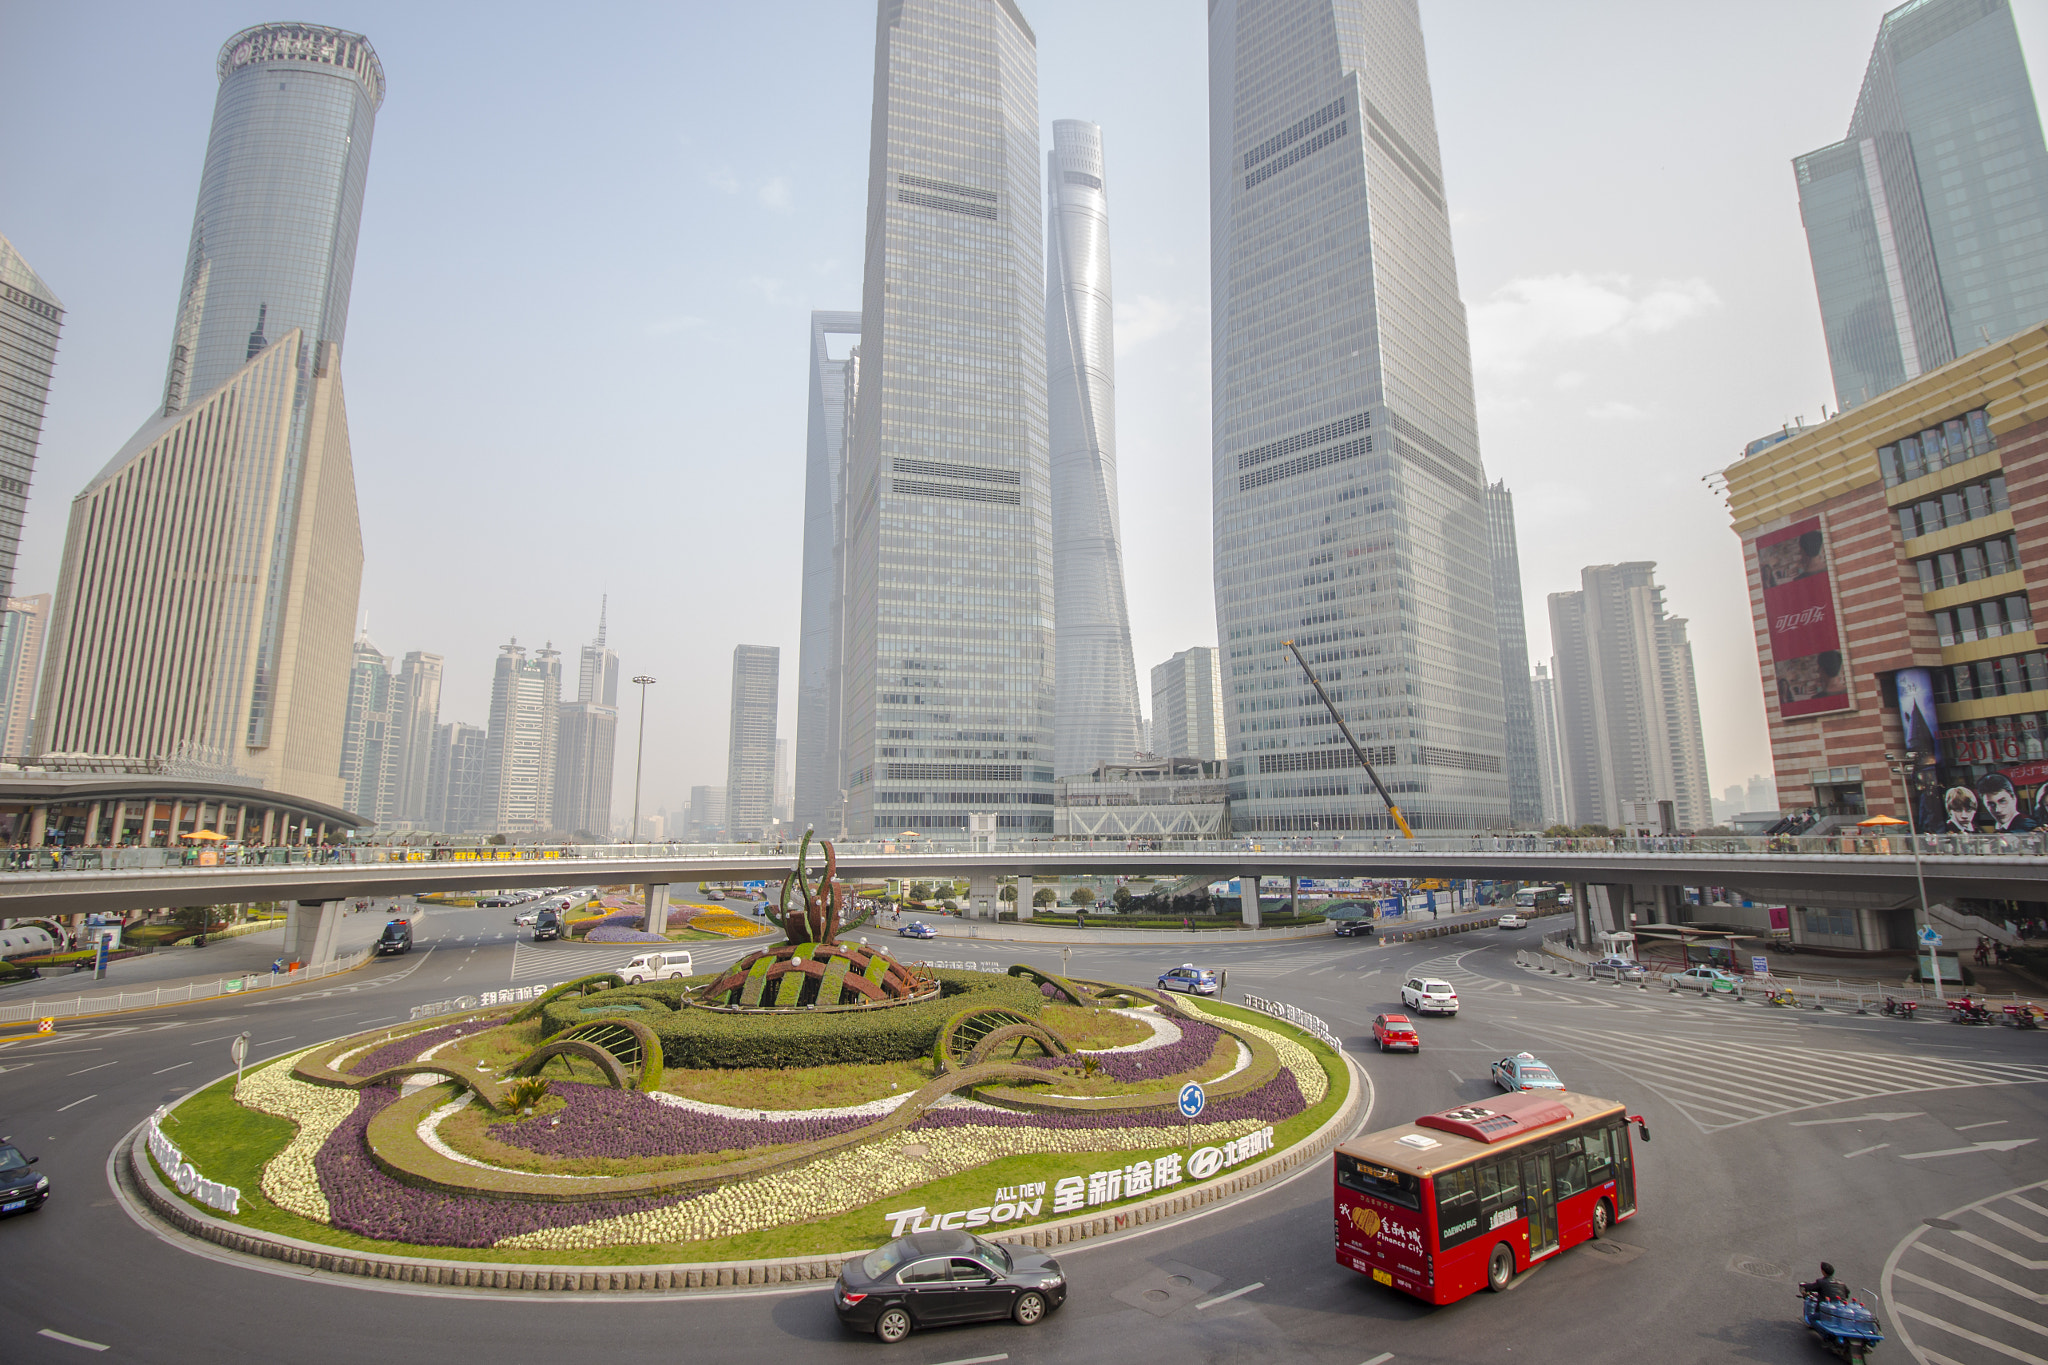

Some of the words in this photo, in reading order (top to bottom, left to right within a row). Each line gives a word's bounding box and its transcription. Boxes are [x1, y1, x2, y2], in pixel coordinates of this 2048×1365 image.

[1775, 603, 1827, 634] 可口可乐
[2002, 720, 2036, 733] YEAR
[1956, 736, 2020, 762] 2016
[1222, 1125, 1274, 1168] 北京现代
[994, 1186, 1018, 1202] ALL
[1052, 1152, 1183, 1213] 全新途胜
[885, 1198, 1043, 1238] TUCSON
[1443, 1221, 1467, 1239] DAEWOO
[1466, 1217, 1478, 1229] BUS
[1377, 1231, 1406, 1248] Finance
[1408, 1243, 1424, 1257] City
